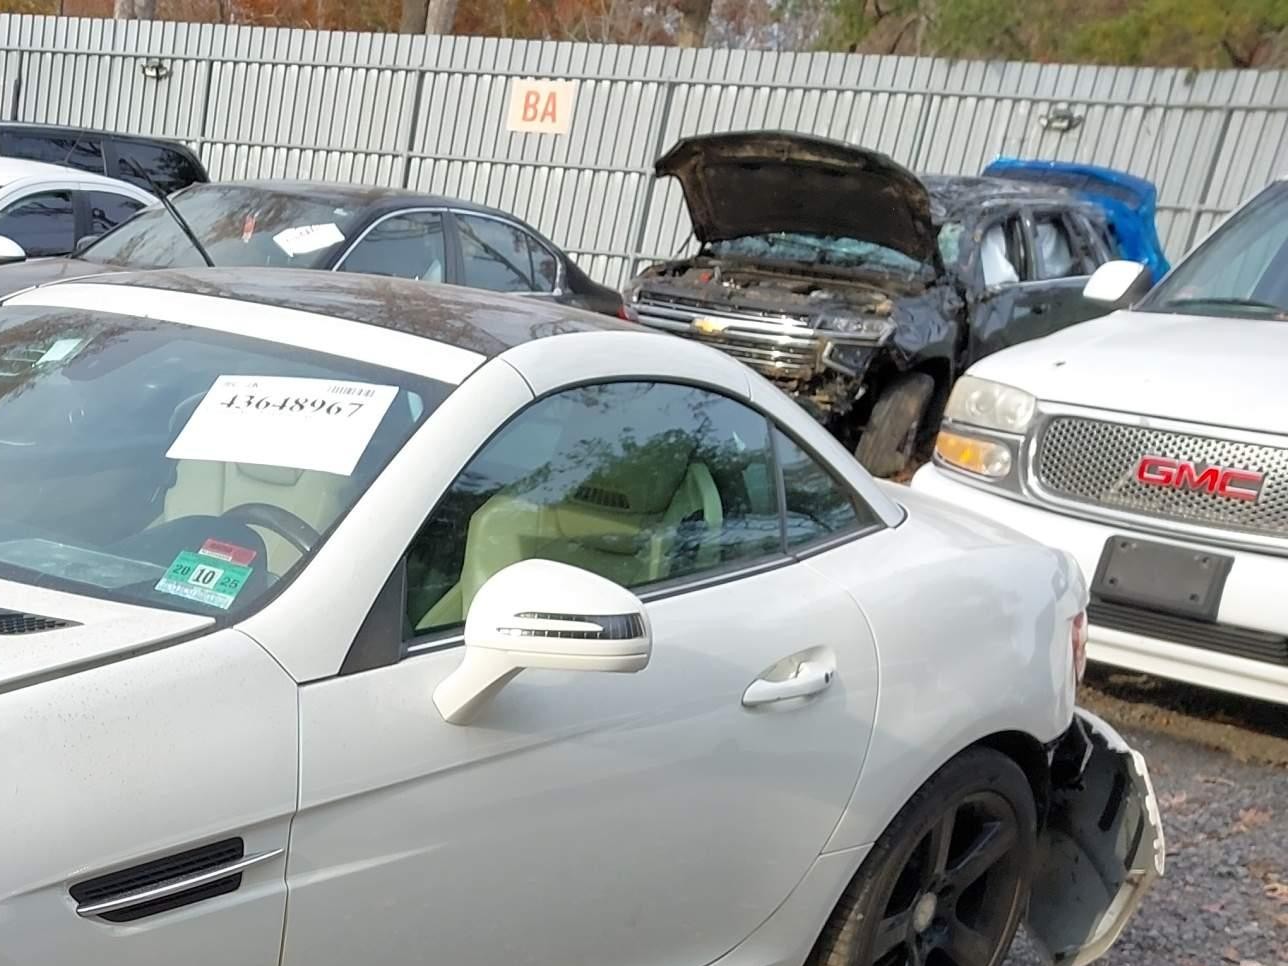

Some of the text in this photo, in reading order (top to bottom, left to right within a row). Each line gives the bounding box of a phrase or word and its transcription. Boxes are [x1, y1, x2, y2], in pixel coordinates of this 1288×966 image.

[522, 90, 557, 124] BA
[220, 393, 365, 418] 43648967
[1135, 454, 1265, 502] GMC
[173, 563, 239, 589] 20 10 25
